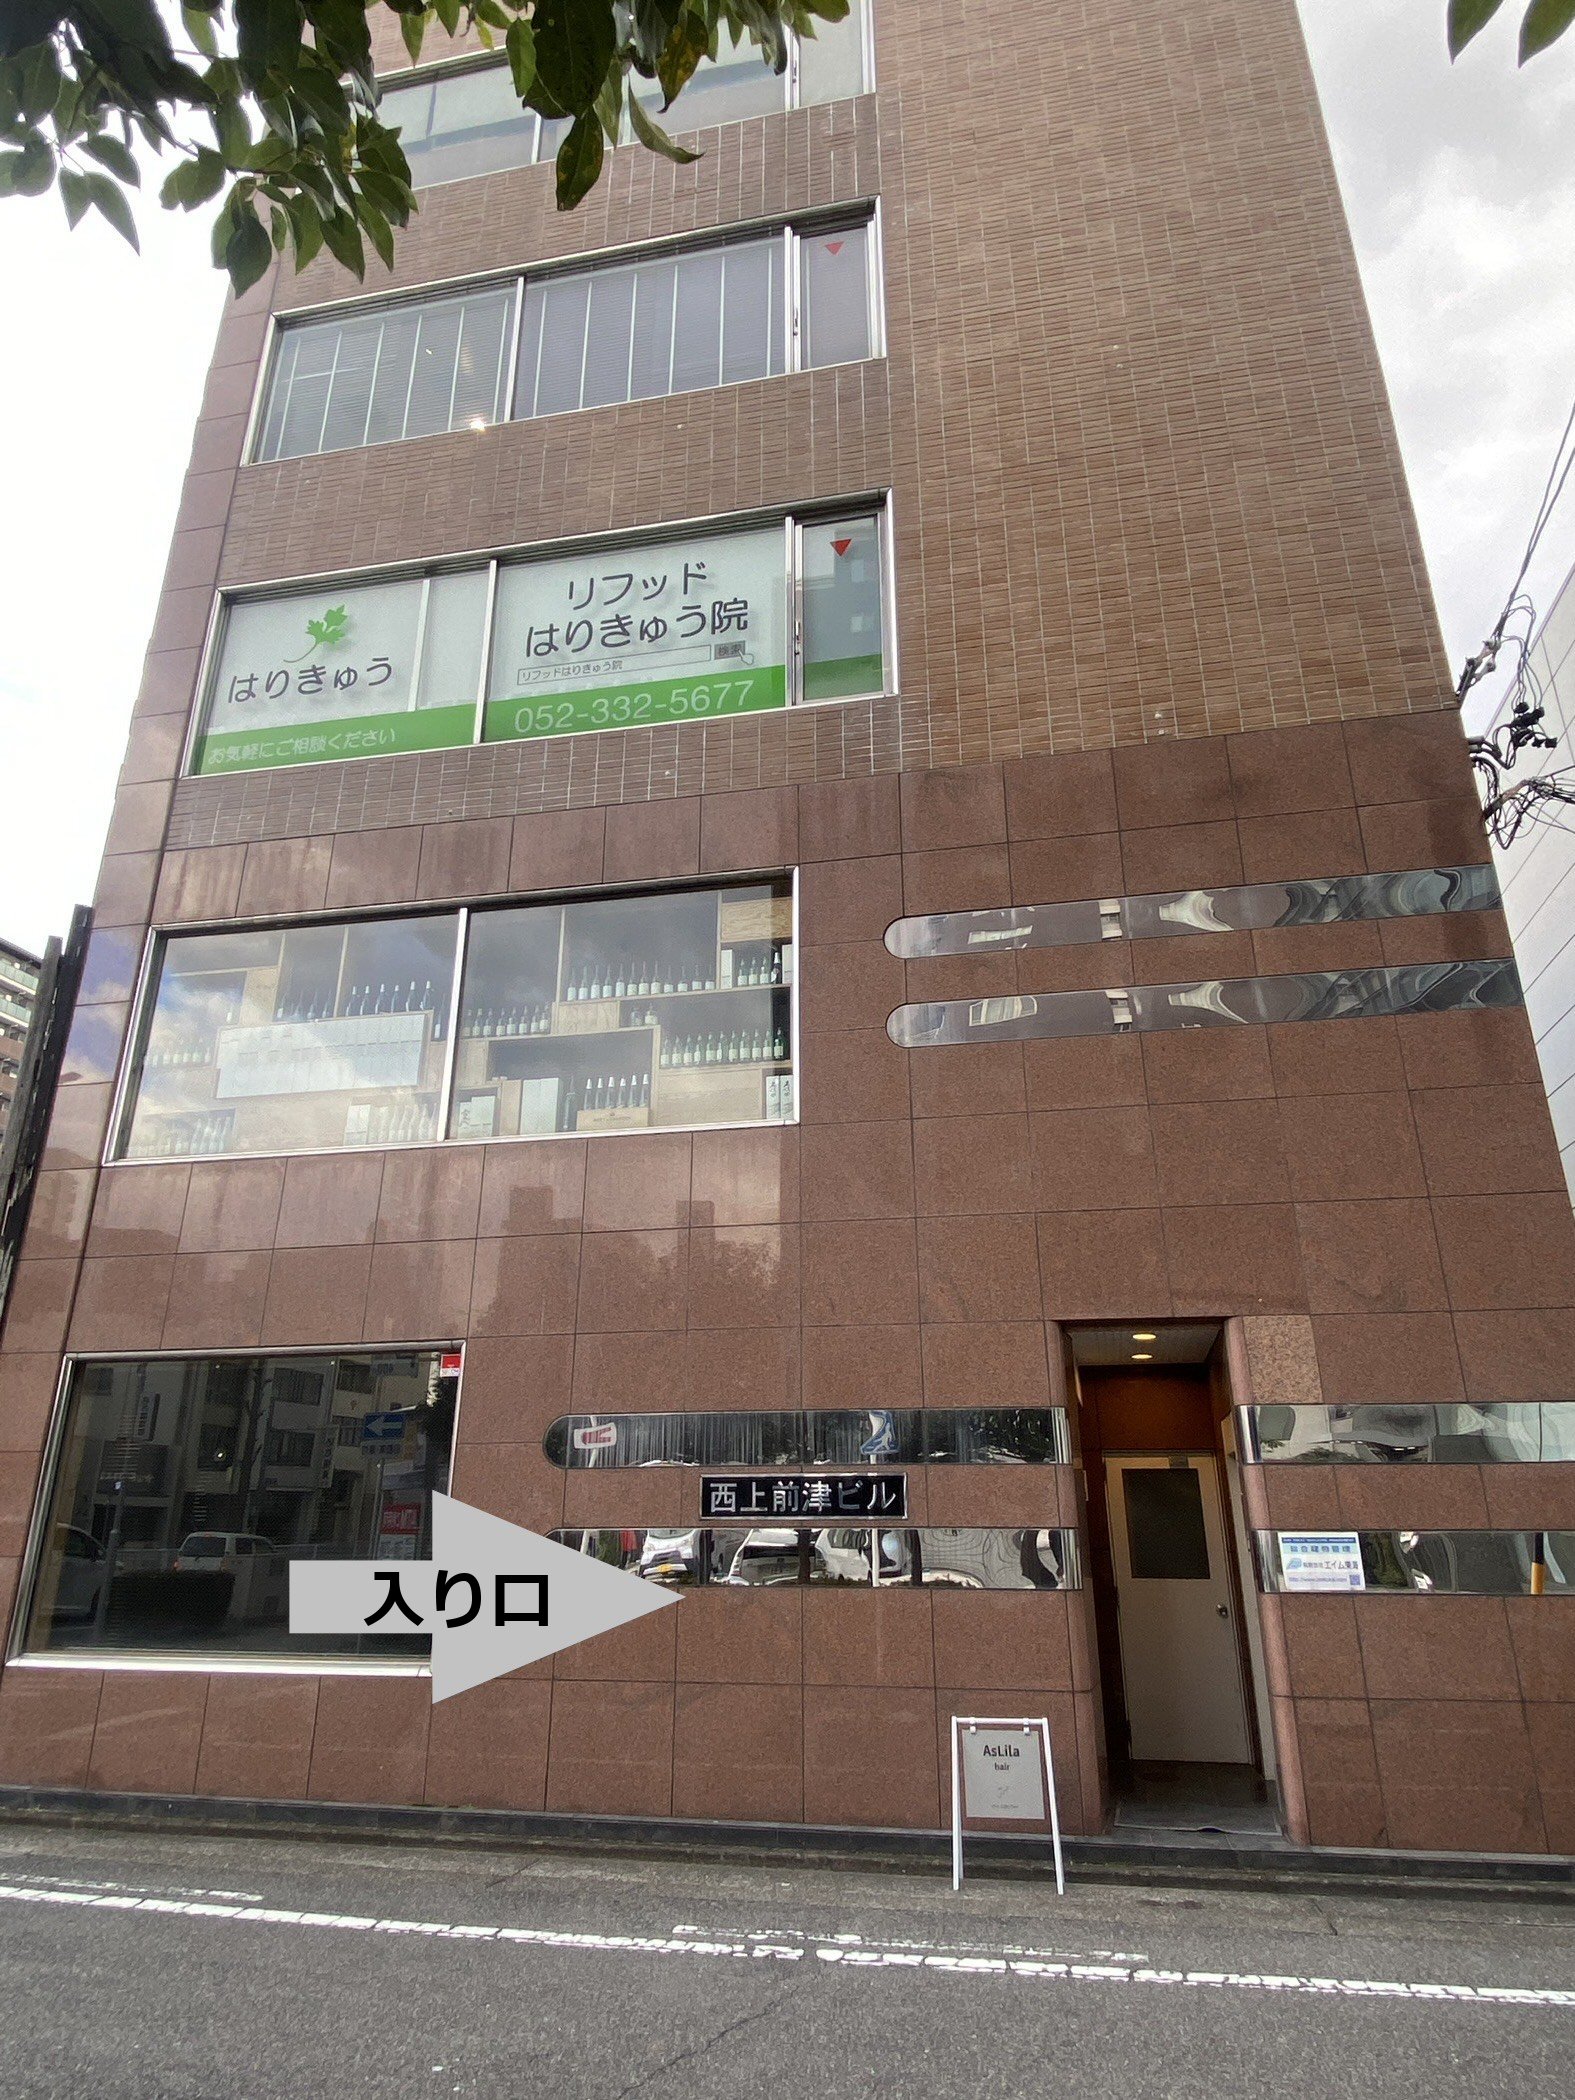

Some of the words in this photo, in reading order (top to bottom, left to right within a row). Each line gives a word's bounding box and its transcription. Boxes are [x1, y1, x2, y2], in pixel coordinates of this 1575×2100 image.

[568, 562, 708, 610] リフッド
[525, 597, 749, 658] はりきゅう院
[228, 656, 393, 704] はりきゅう
[522, 660, 623, 682] リフッドはりきゅう院
[514, 679, 755, 733] 052-332-5677
[208, 728, 396, 765] お気軽にご相談ください
[709, 1479, 897, 1513] 西上前津ビル
[983, 1744, 1020, 1758] AsLila
[994, 1762, 1010, 1771] hair
